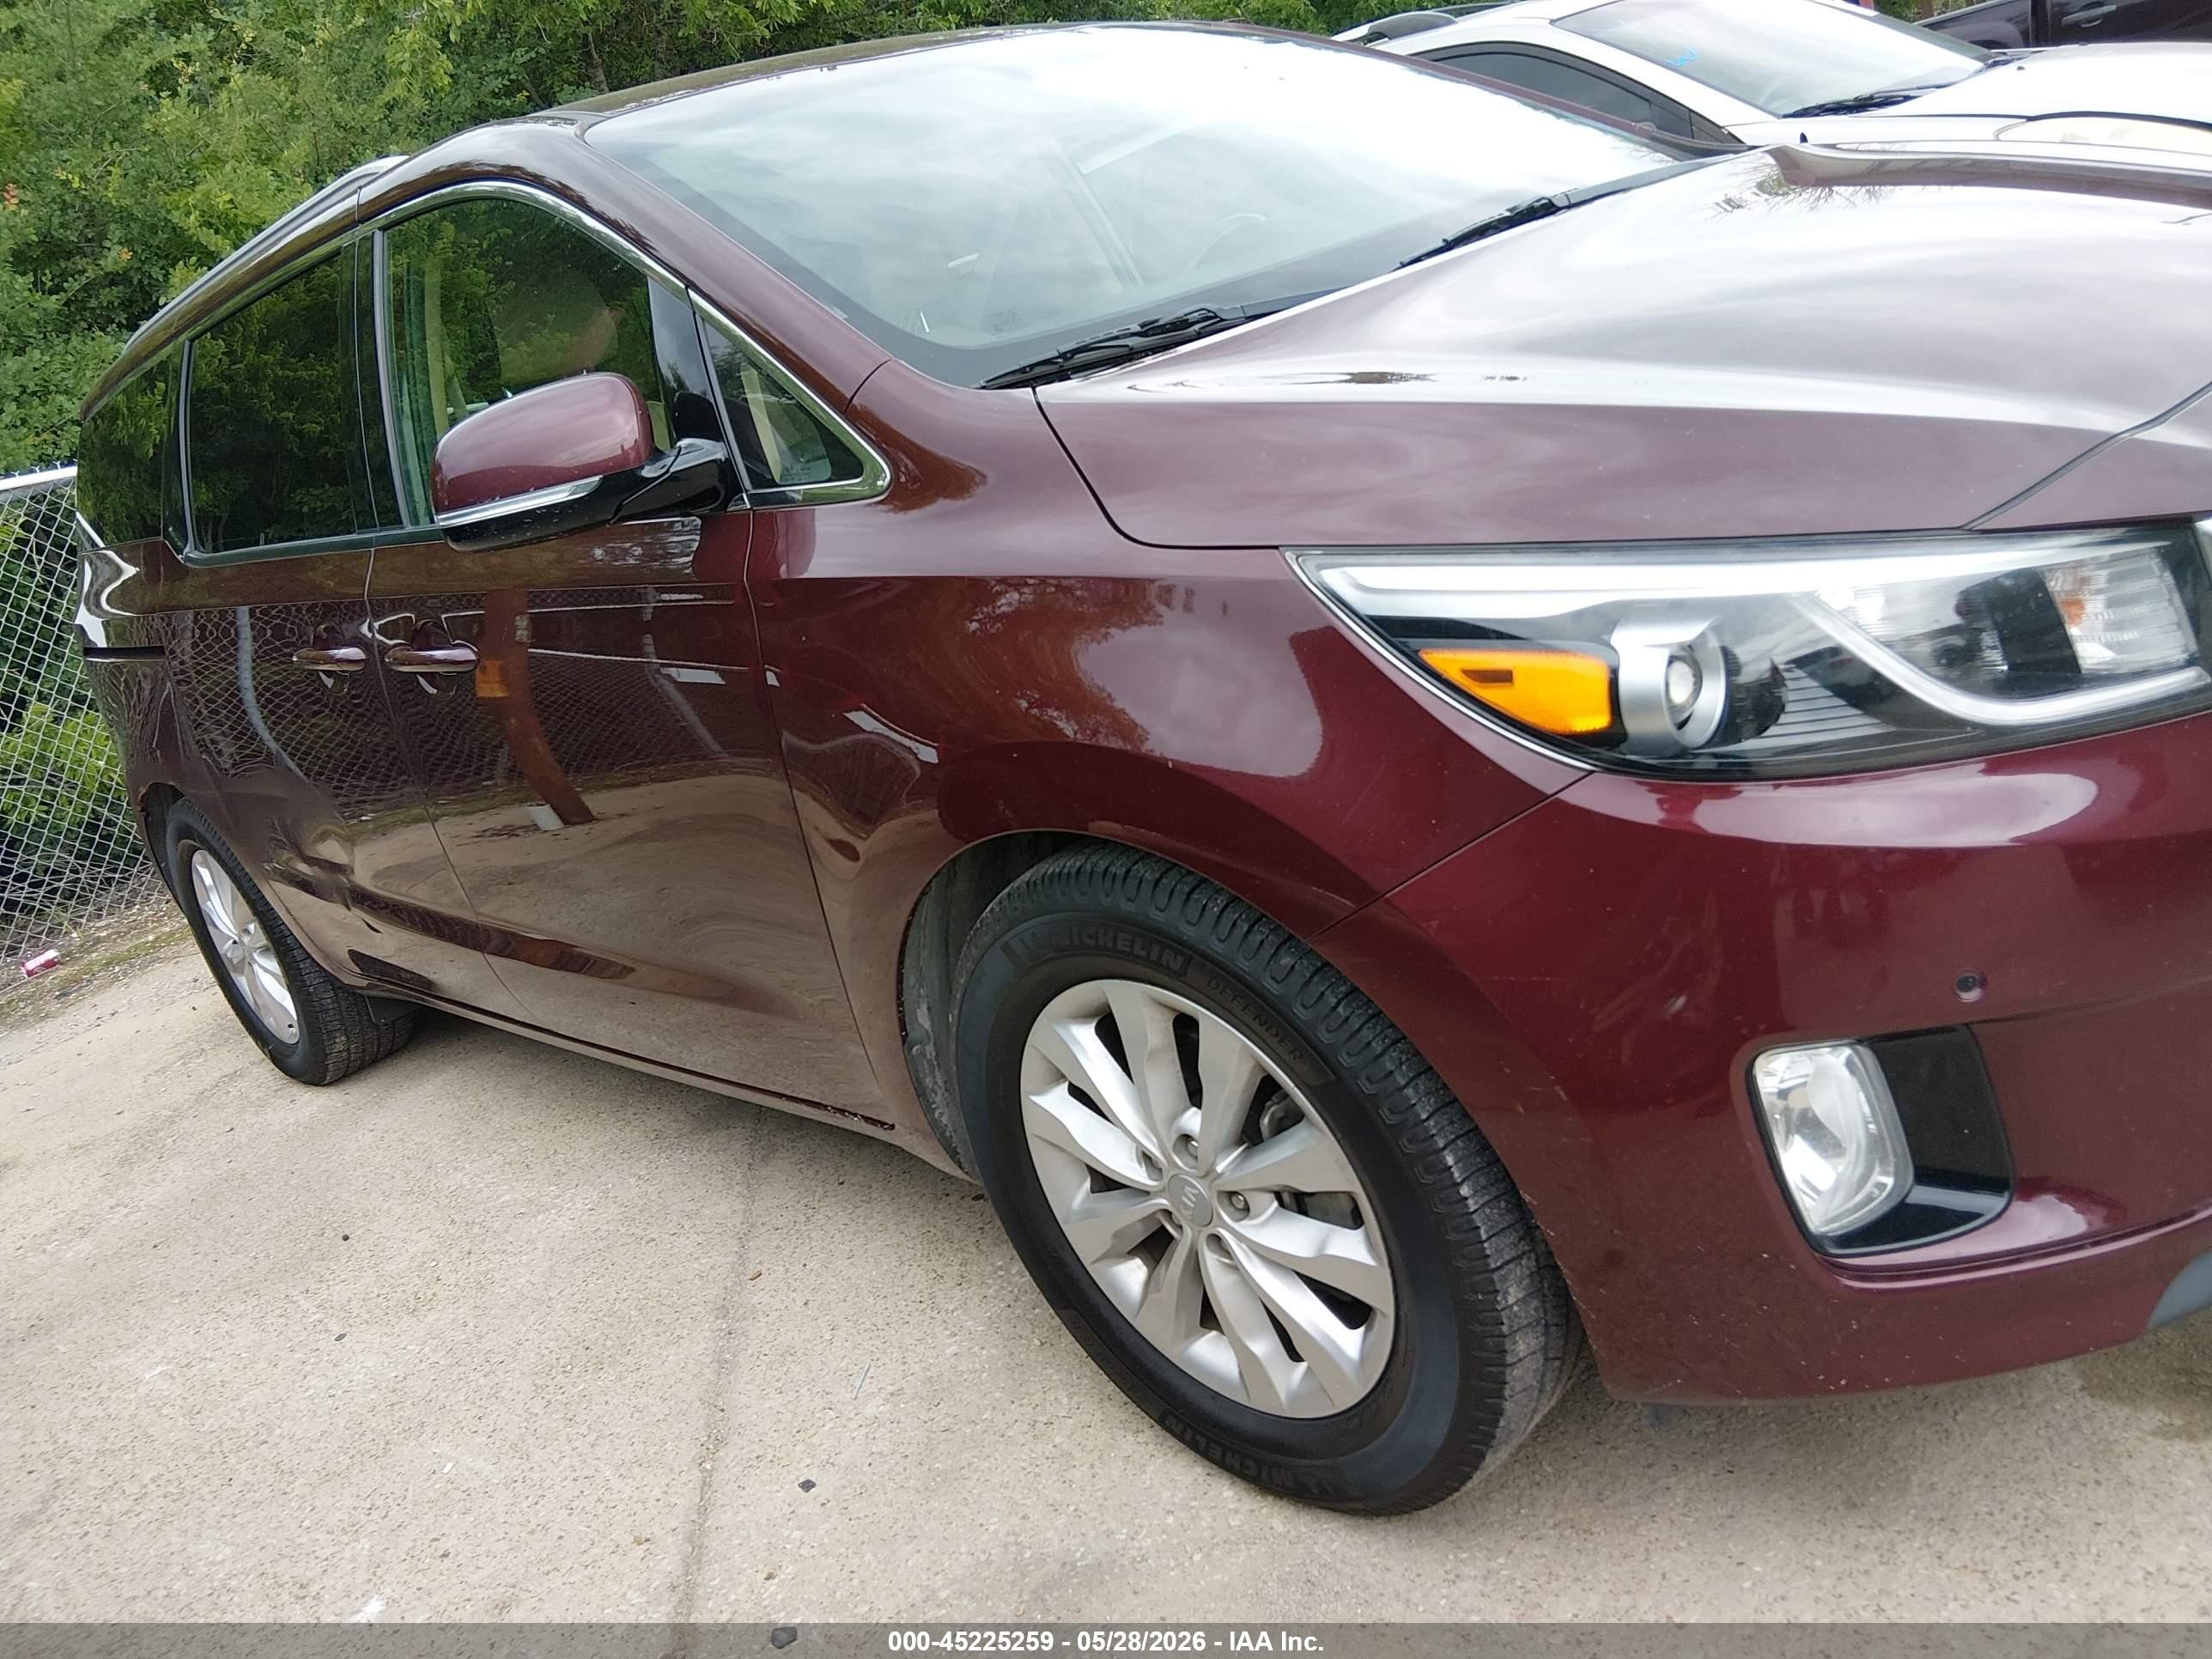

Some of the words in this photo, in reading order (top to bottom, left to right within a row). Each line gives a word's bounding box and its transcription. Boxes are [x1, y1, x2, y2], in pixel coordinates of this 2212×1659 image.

[1052, 927, 1184, 969] MICHELIN
[1207, 978, 1304, 1061] DEFENDER
[1164, 1413, 1295, 1489] MICHELIN
